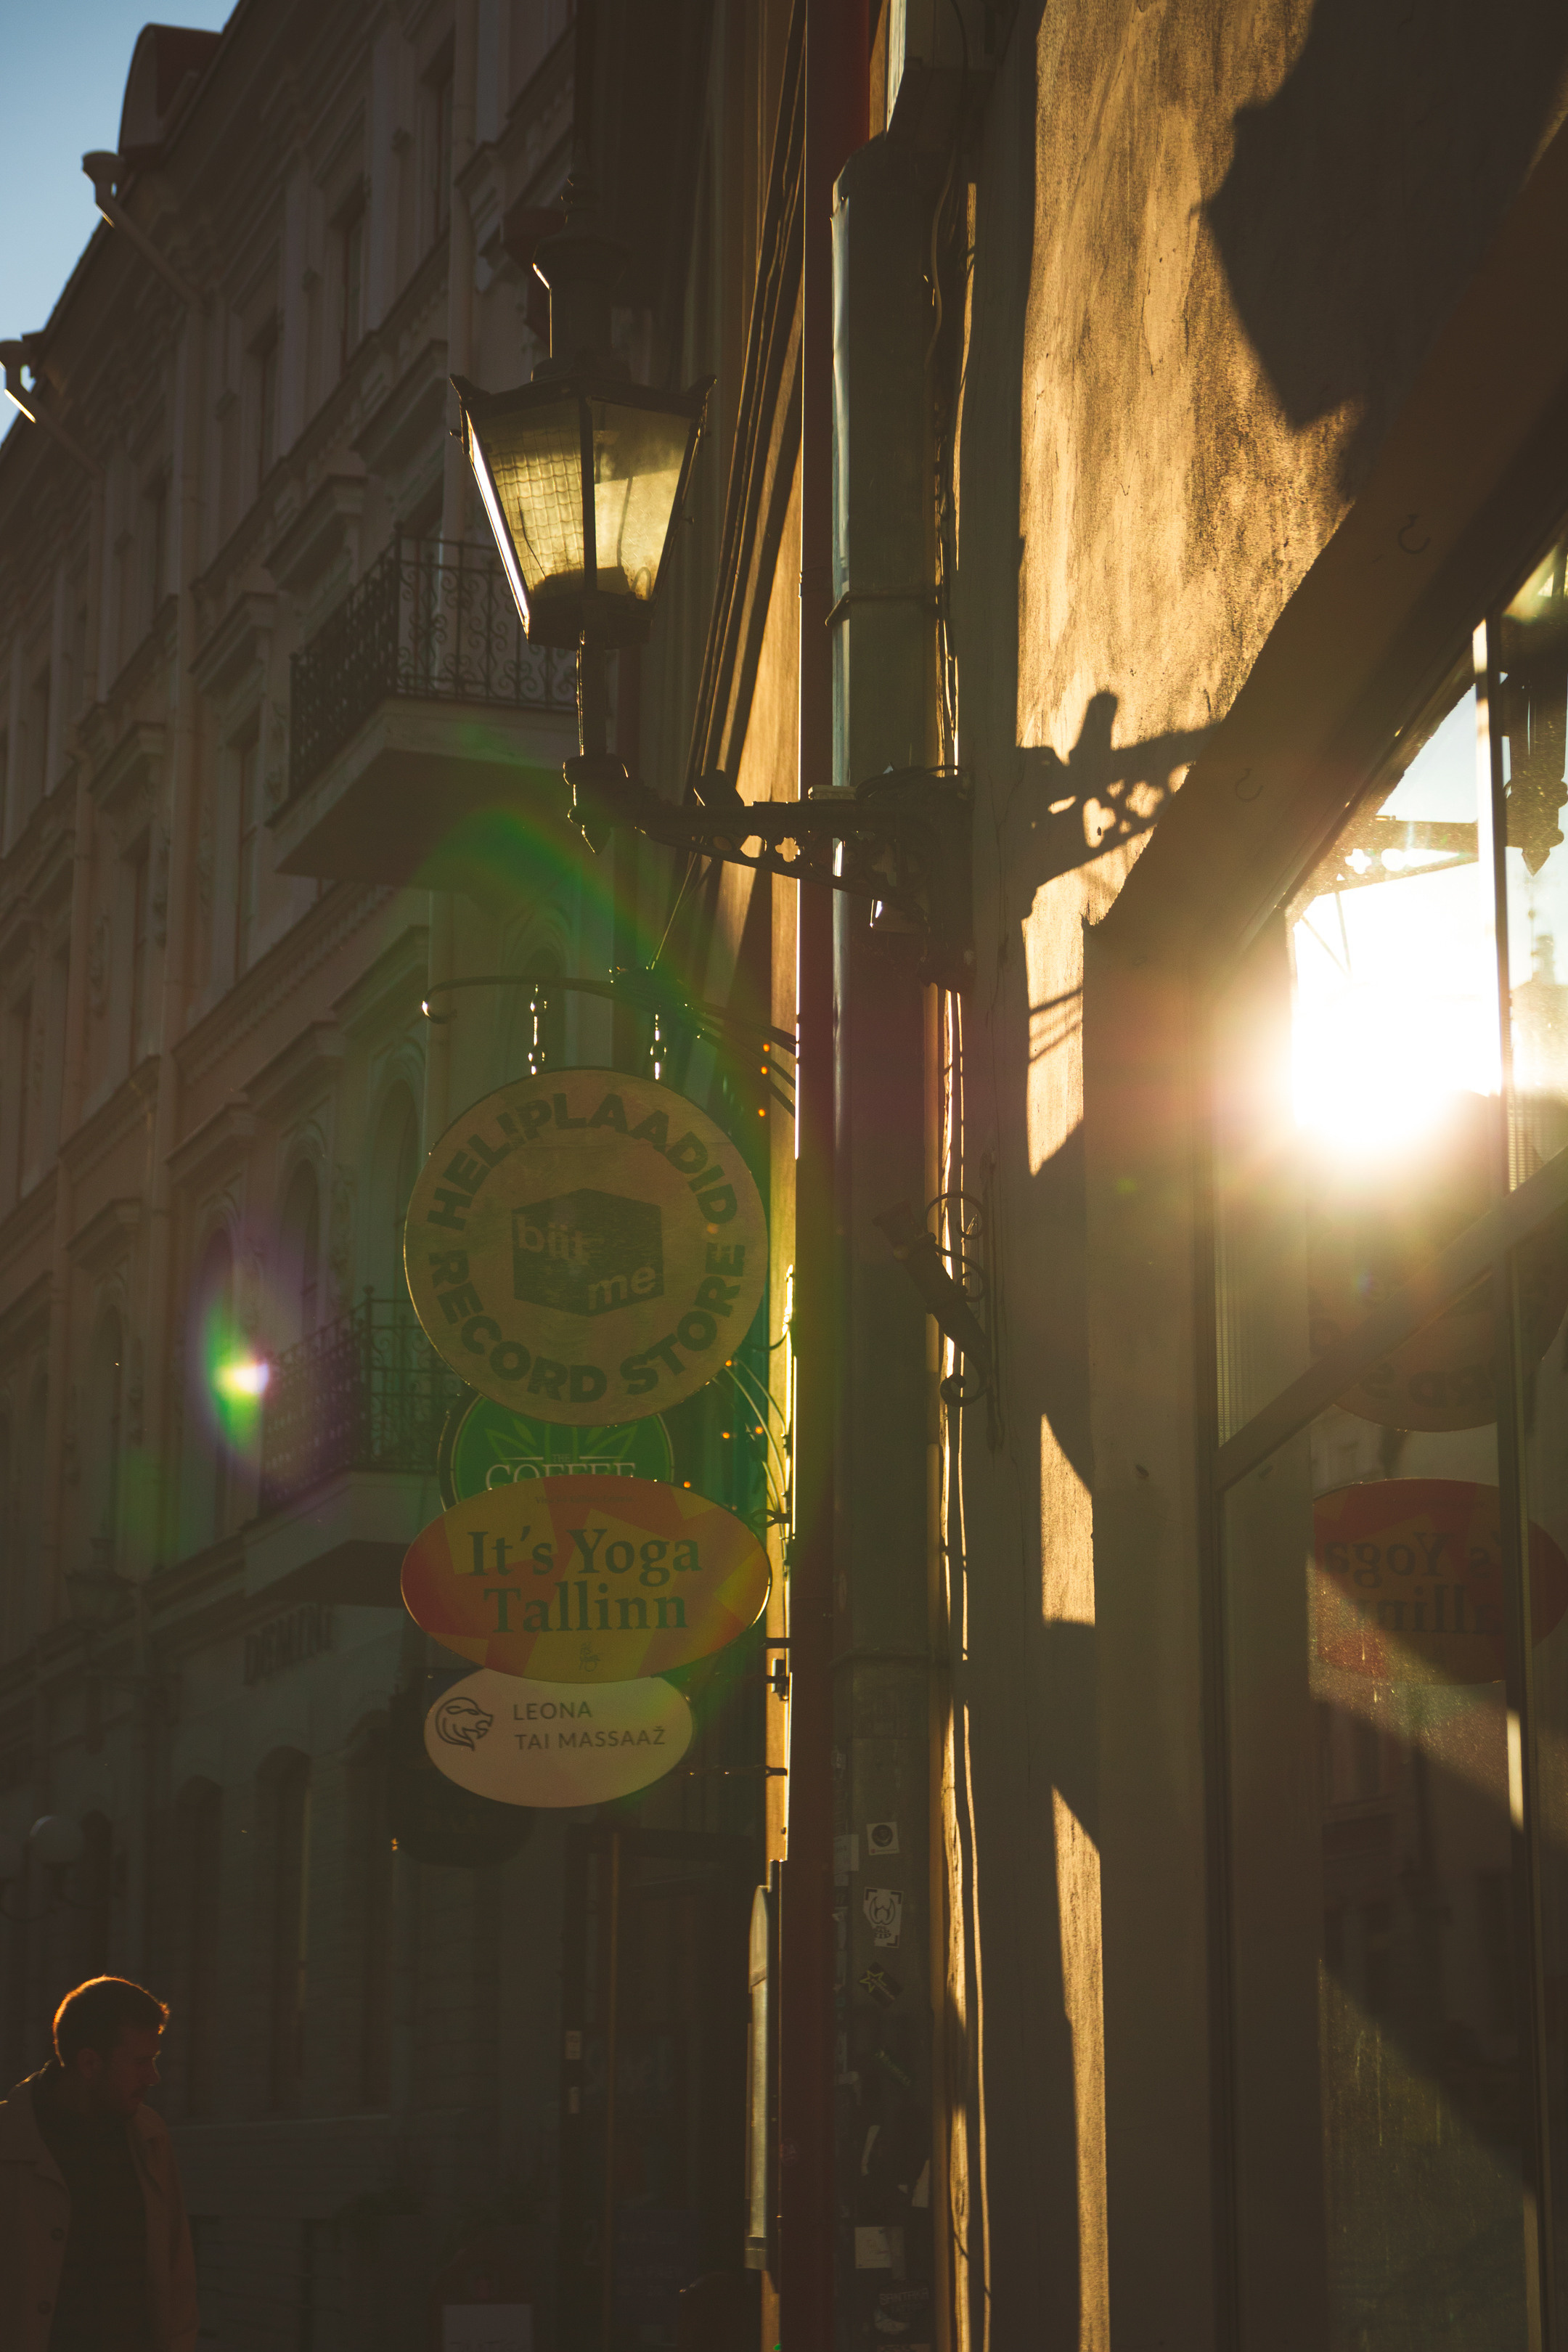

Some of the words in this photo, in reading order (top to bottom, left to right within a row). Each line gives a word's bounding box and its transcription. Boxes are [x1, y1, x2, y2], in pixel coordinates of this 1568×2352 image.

[588, 1265, 657, 1310] me
[428, 1249, 608, 1403] RECORD
[620, 1242, 746, 1395] STORE
[565, 1528, 703, 1588] Yoga
[483, 1580, 687, 1633] Tallinn
[513, 1701, 592, 1720] LEONA
[515, 1733, 550, 1750] TAI
[558, 1726, 666, 1749] MASSAAŽ
